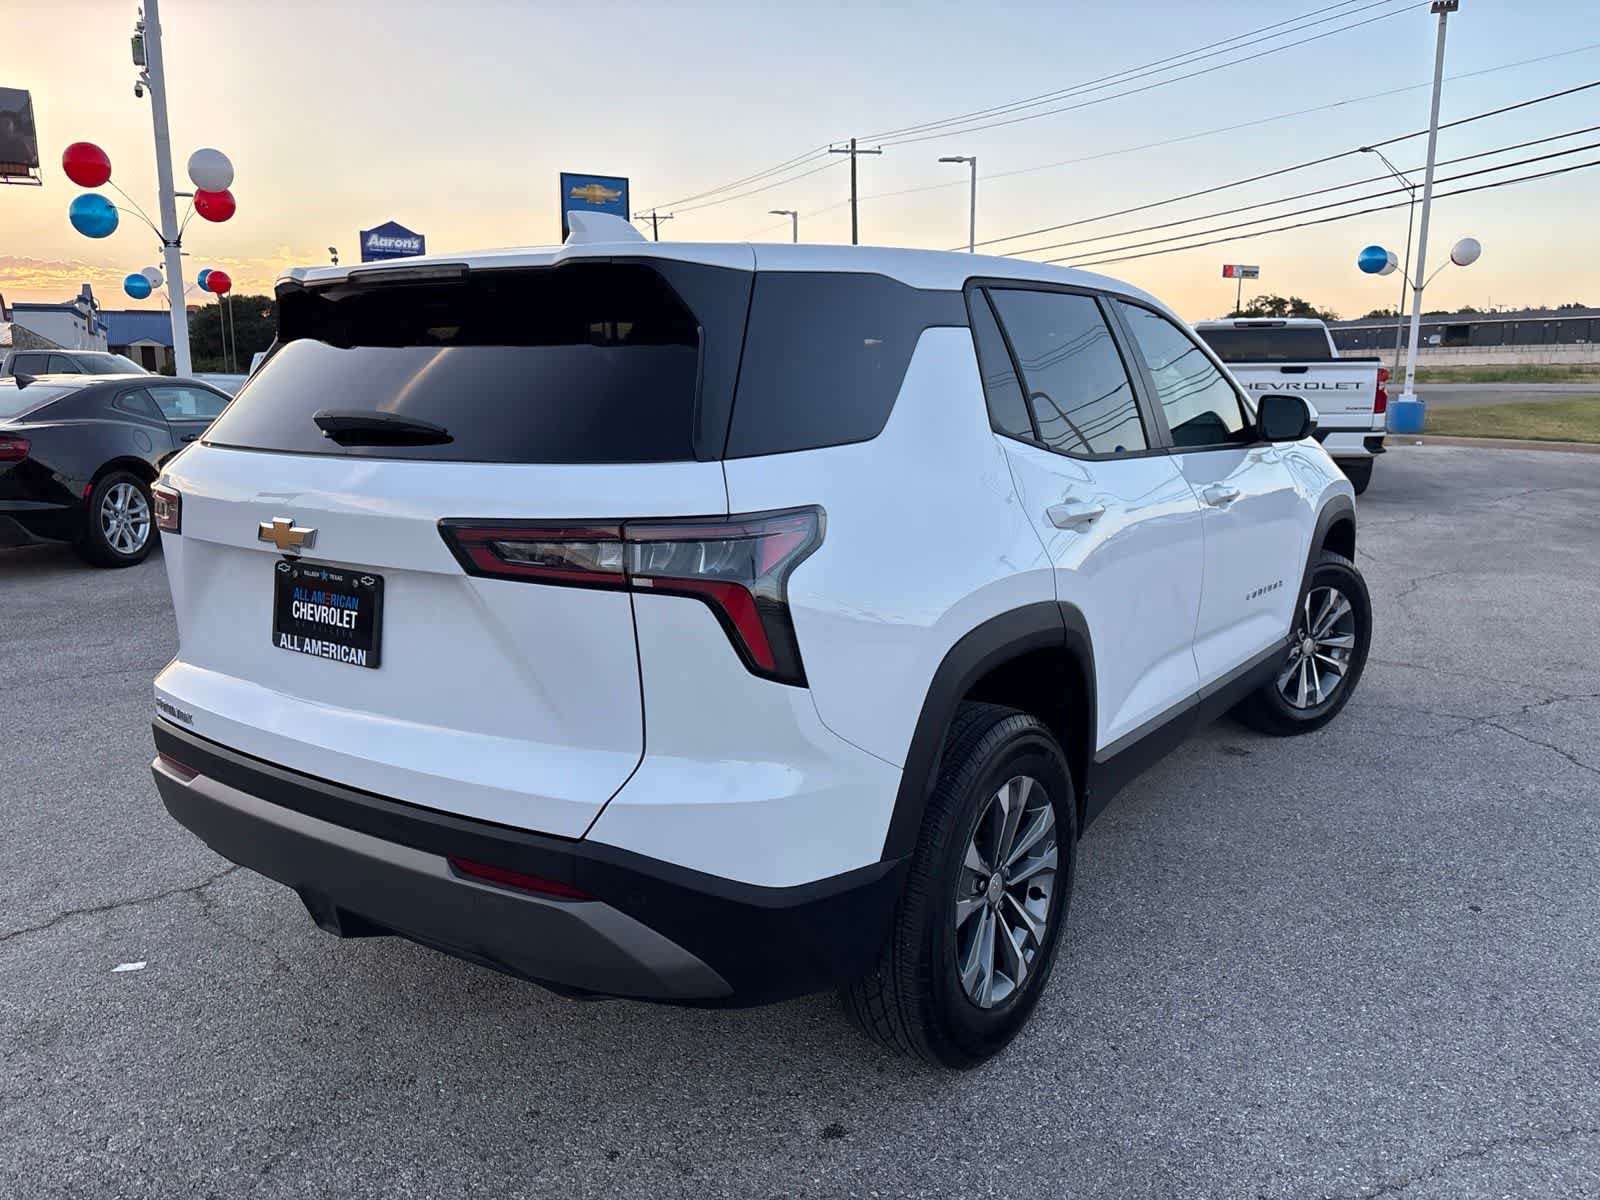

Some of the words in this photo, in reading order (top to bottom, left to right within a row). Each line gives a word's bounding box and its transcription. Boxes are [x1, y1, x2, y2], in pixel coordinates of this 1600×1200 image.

[367, 234, 419, 249] Aaron's
[1243, 382, 1364, 391] HEVROLET
[293, 588, 309, 601] ALL
[311, 591, 359, 610] AMERICAN
[293, 601, 358, 629] CHEVROLET
[279, 633, 301, 651] ALL
[303, 638, 366, 665] AMERICAN
